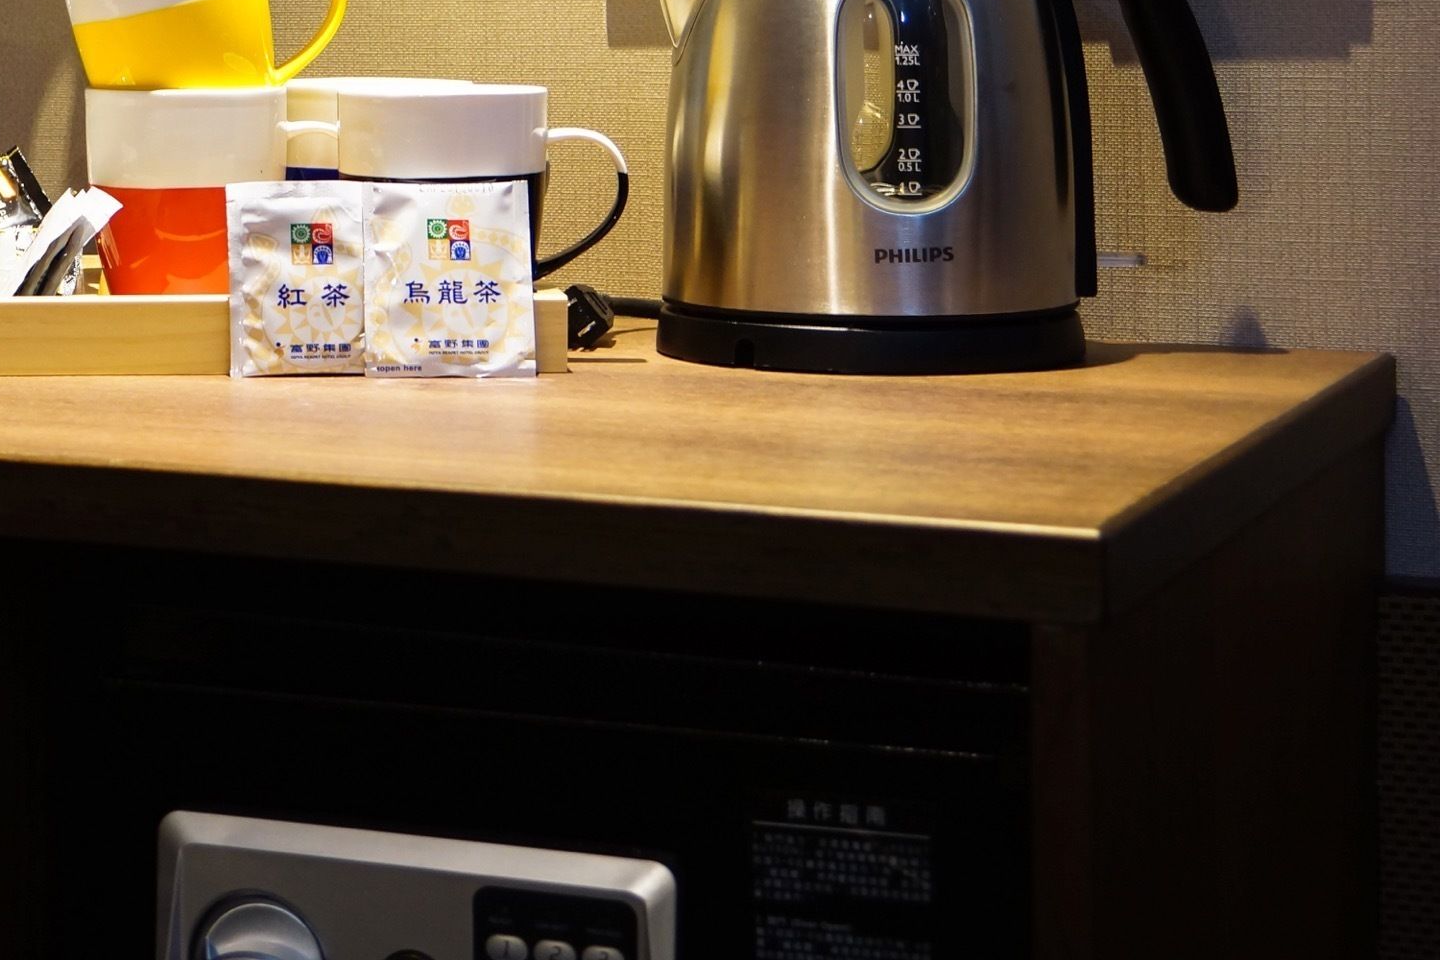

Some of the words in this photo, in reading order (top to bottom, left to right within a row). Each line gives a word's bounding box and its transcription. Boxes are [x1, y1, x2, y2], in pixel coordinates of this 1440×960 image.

[894, 43, 919, 55] MAX
[894, 55, 921, 66] 1.25L
[896, 79, 905, 90] 4
[897, 92, 912, 104] 1.0
[898, 113, 906, 126] 3
[898, 148, 906, 160] 2
[898, 161, 914, 173] 0.5
[874, 247, 954, 264] PHILIPS
[277, 283, 350, 309] 紅茶
[403, 279, 502, 305] 烏龍茶
